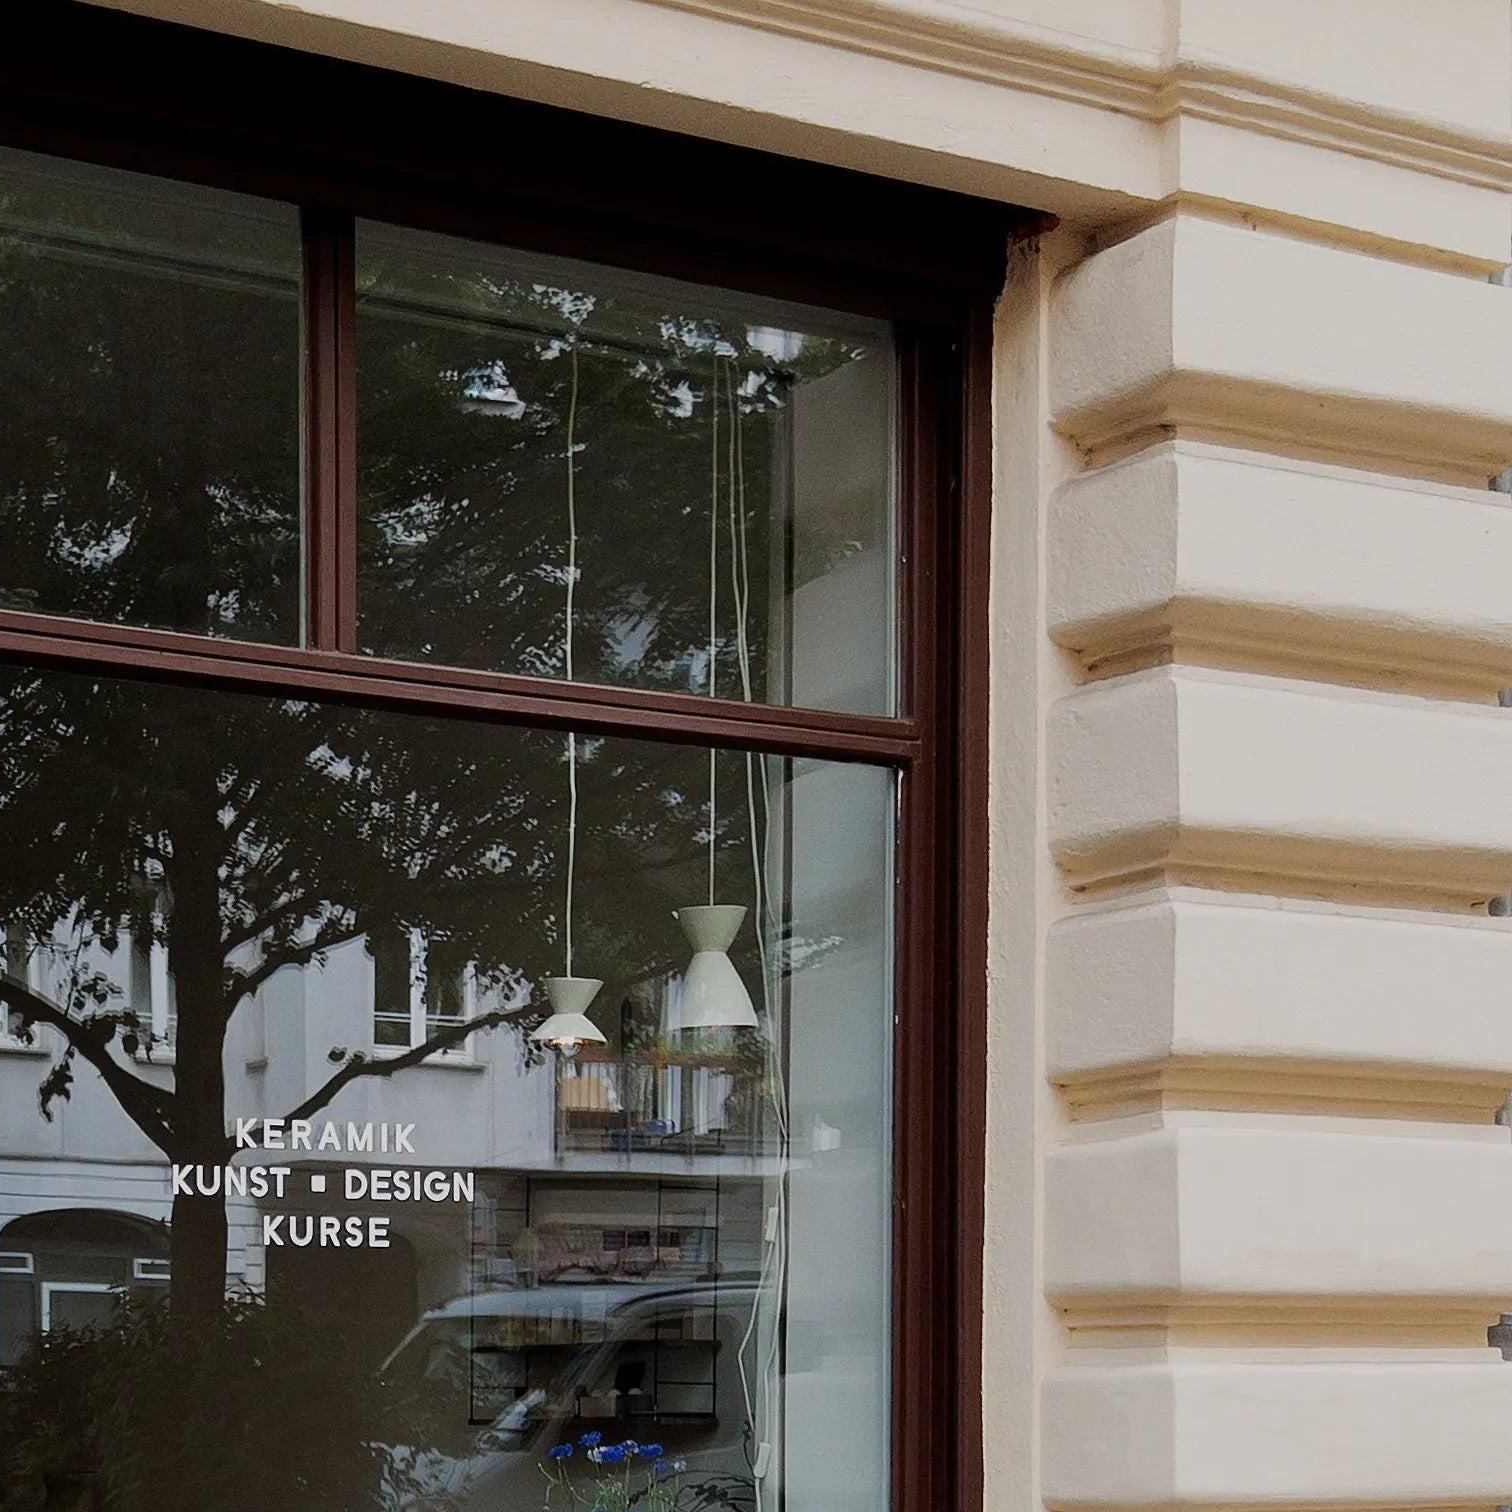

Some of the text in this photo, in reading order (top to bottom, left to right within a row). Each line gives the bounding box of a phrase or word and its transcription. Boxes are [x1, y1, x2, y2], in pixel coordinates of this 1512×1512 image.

[236, 1117, 416, 1153] KERAMIK
[172, 1164, 475, 1202] KUNST DESIGN
[263, 1215, 391, 1248] KURSE
